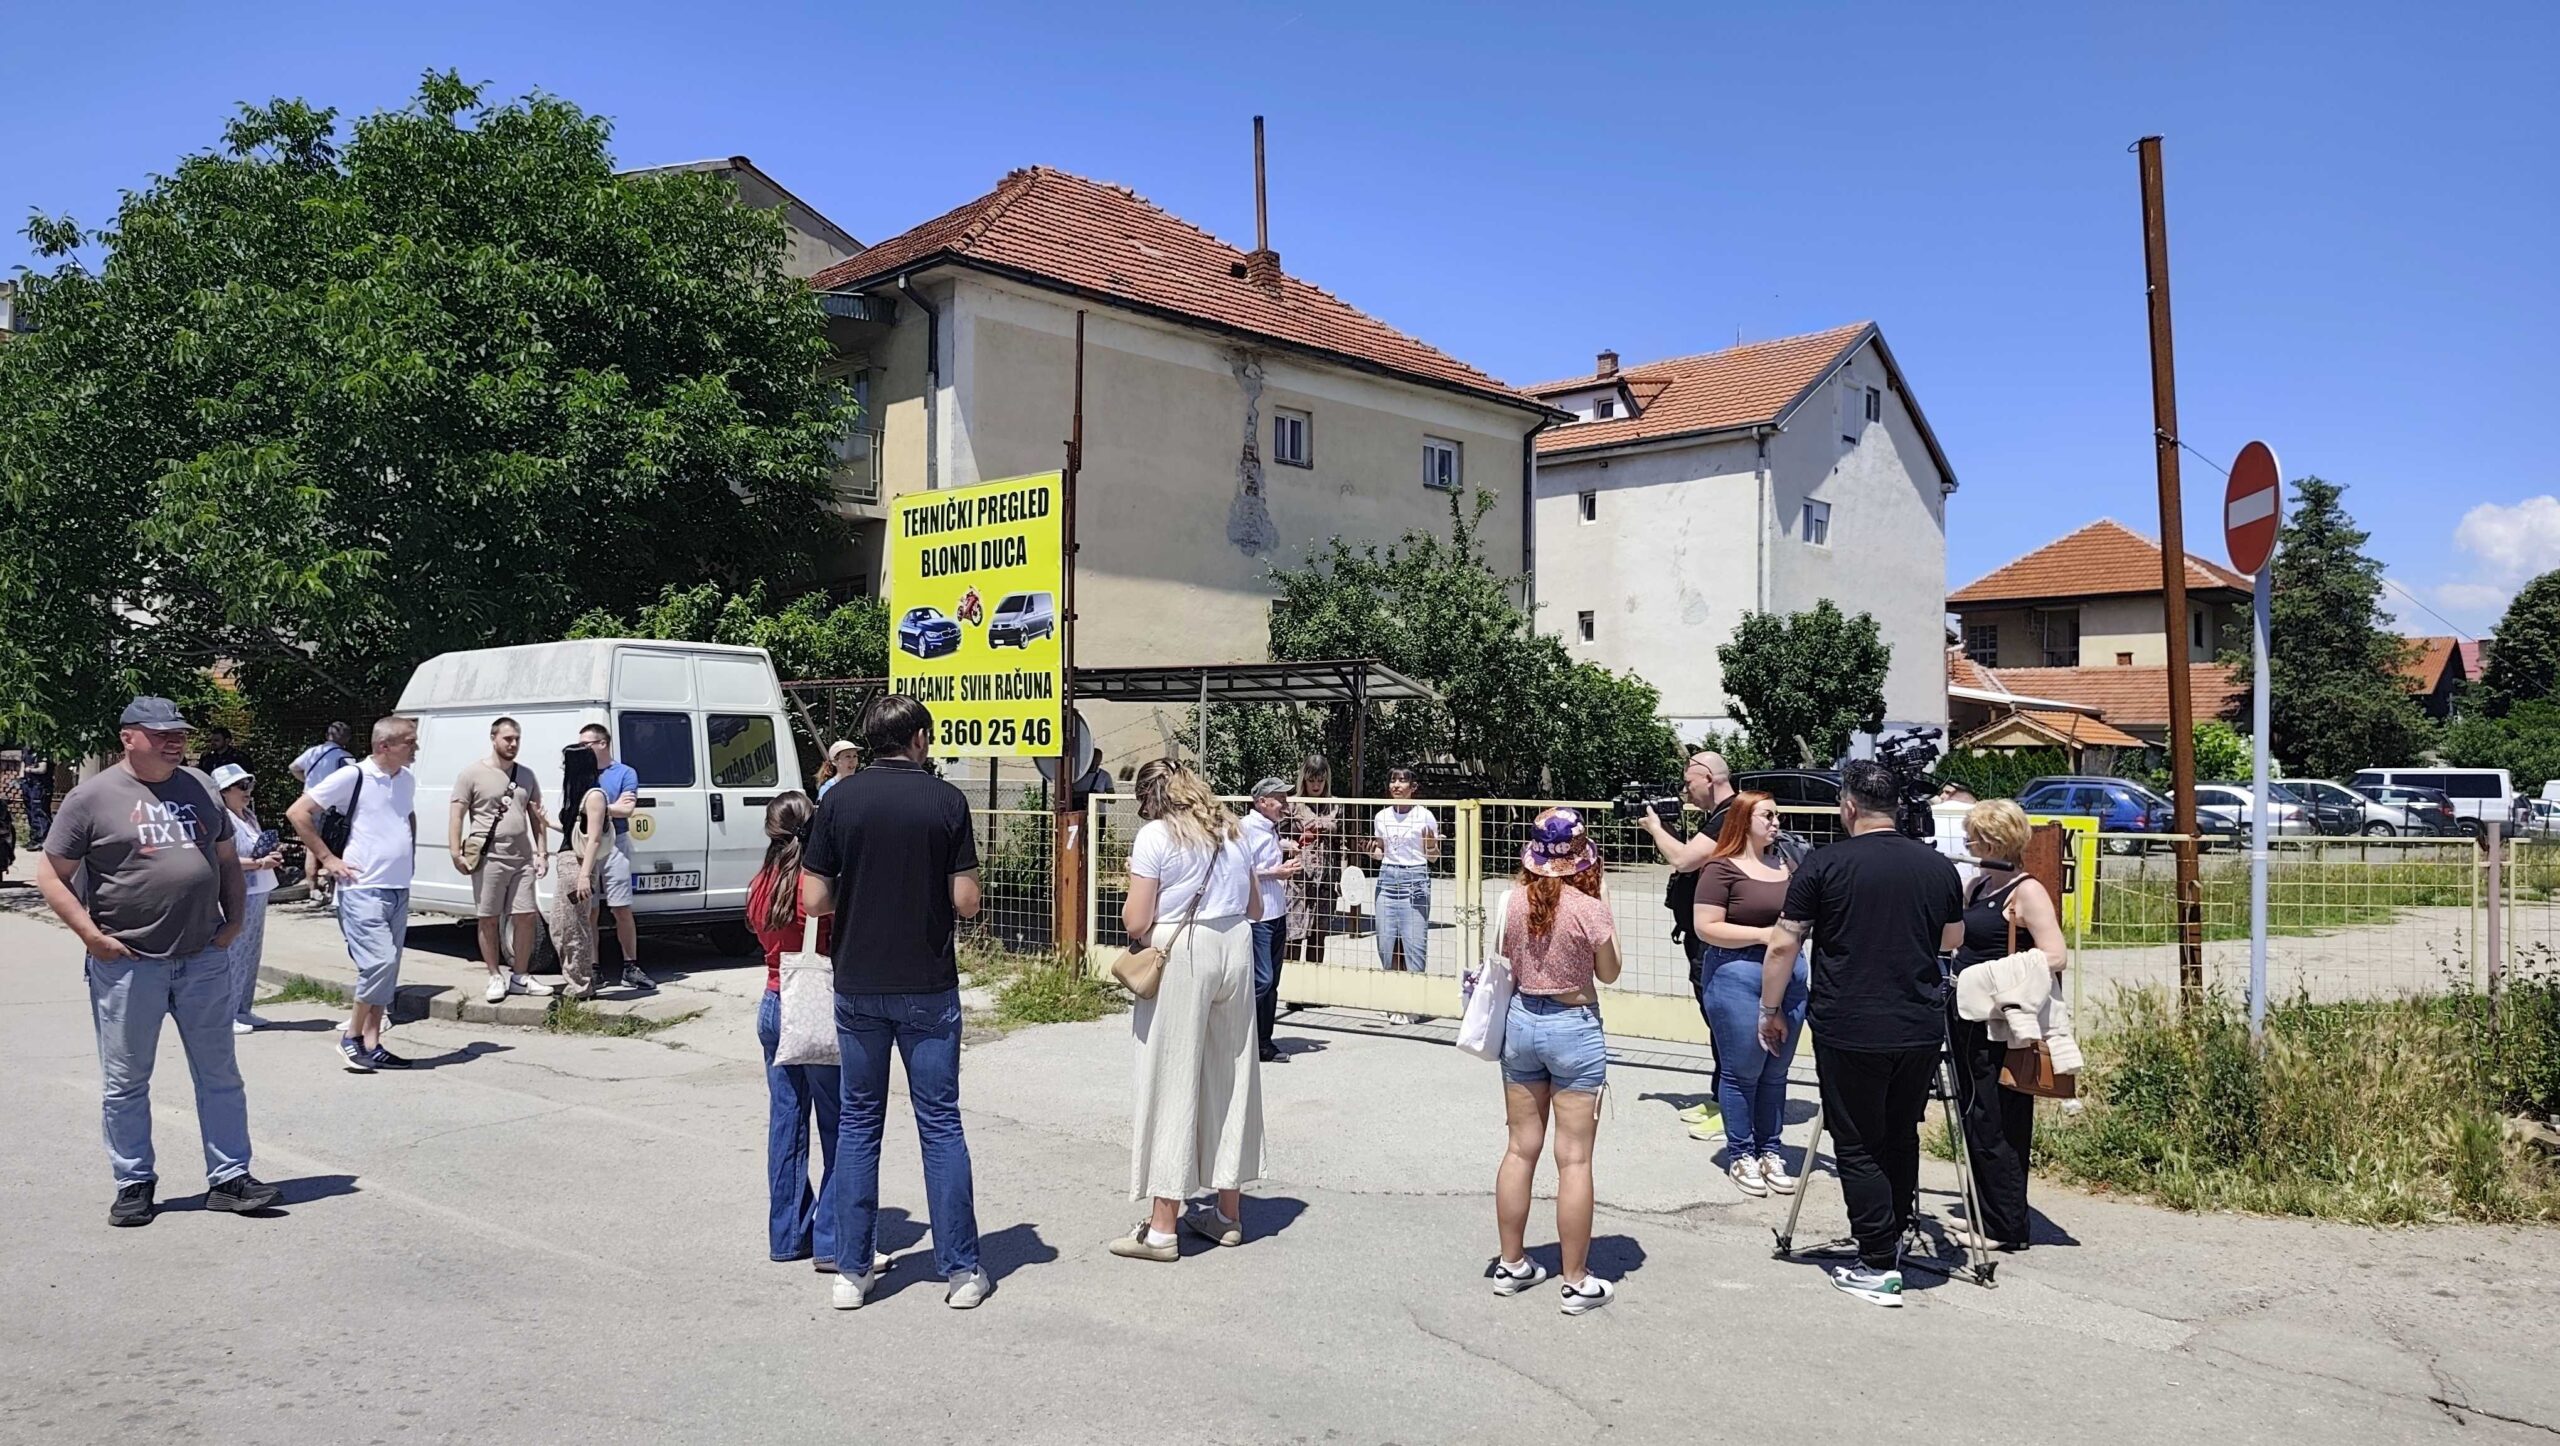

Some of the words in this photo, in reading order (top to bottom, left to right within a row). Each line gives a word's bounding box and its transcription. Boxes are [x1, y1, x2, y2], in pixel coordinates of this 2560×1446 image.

[903, 496, 973, 538] TEHNIČKI
[977, 487, 1050, 527] PREGLED
[922, 542, 976, 578] BLONDI
[981, 535, 1027, 570] DUCA
[961, 674, 991, 701] SVIH
[995, 667, 1053, 701] RAČUNA
[941, 719, 982, 746] 360
[988, 719, 1016, 746] 25
[1021, 718, 1051, 746] 46
[144, 800, 187, 822] MR.
[137, 823, 176, 844] FIX
[176, 820, 197, 841] IT
[636, 819, 649, 833] 80
[1067, 824, 1078, 850] 7
